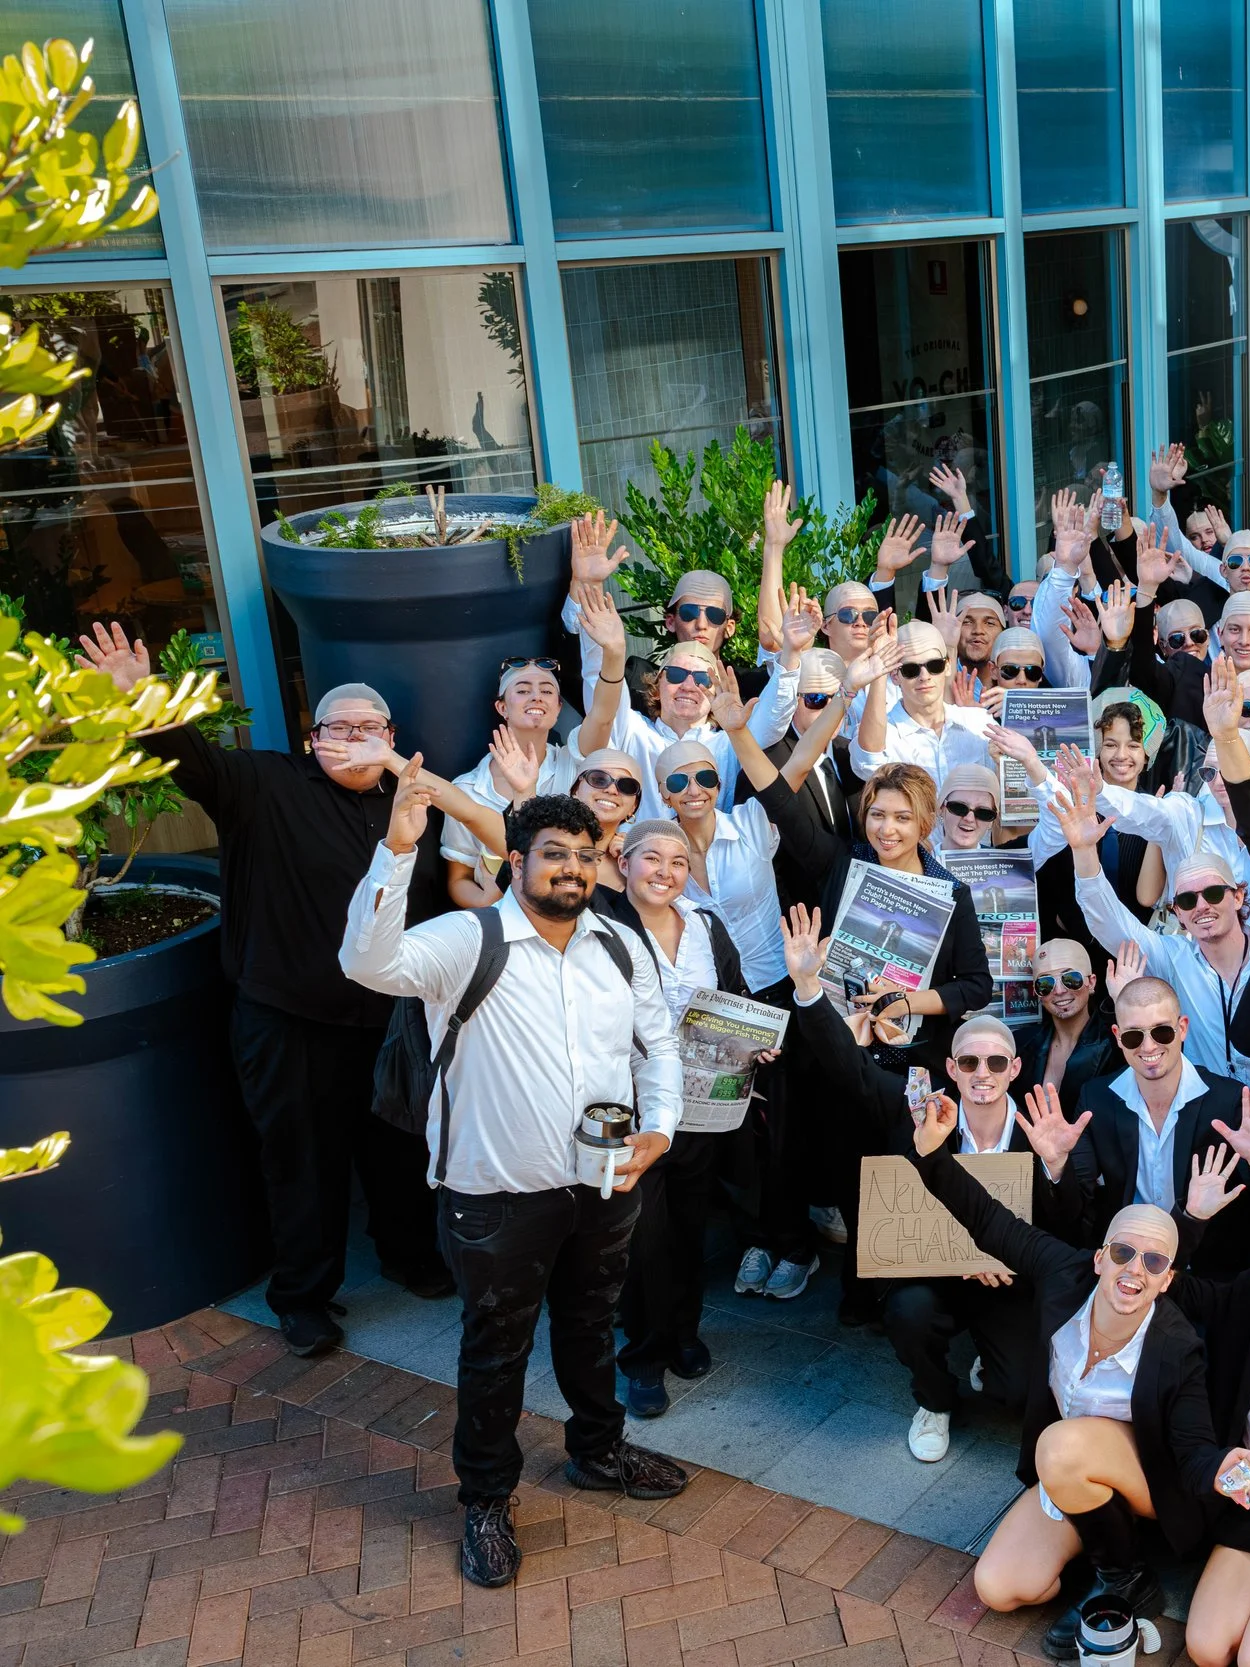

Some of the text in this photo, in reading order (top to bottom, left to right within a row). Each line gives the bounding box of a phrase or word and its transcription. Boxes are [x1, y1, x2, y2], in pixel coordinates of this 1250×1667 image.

[923, 339, 961, 352] ORIGINAL
[866, 882, 888, 895] Perth's
[889, 892, 912, 907] Hottest
[913, 902, 928, 913] New
[870, 898, 887, 911] Page
[883, 896, 895, 906] The
[895, 902, 913, 916] Party
[839, 932, 924, 973] #PROSH
[1008, 960, 1032, 968] MAGA
[696, 991, 709, 1000] The
[709, 993, 744, 1010] Polycrisis
[745, 1003, 784, 1021] Periodical
[685, 1017, 708, 1028] There's
[710, 1024, 734, 1034] Bigger
[735, 1030, 750, 1039] Fish
[761, 1036, 774, 1045] Fry
[688, 1011, 699, 1019] Life
[701, 1013, 724, 1026] Giving
[726, 1021, 740, 1029] You
[742, 1025, 775, 1038] Lemons?
